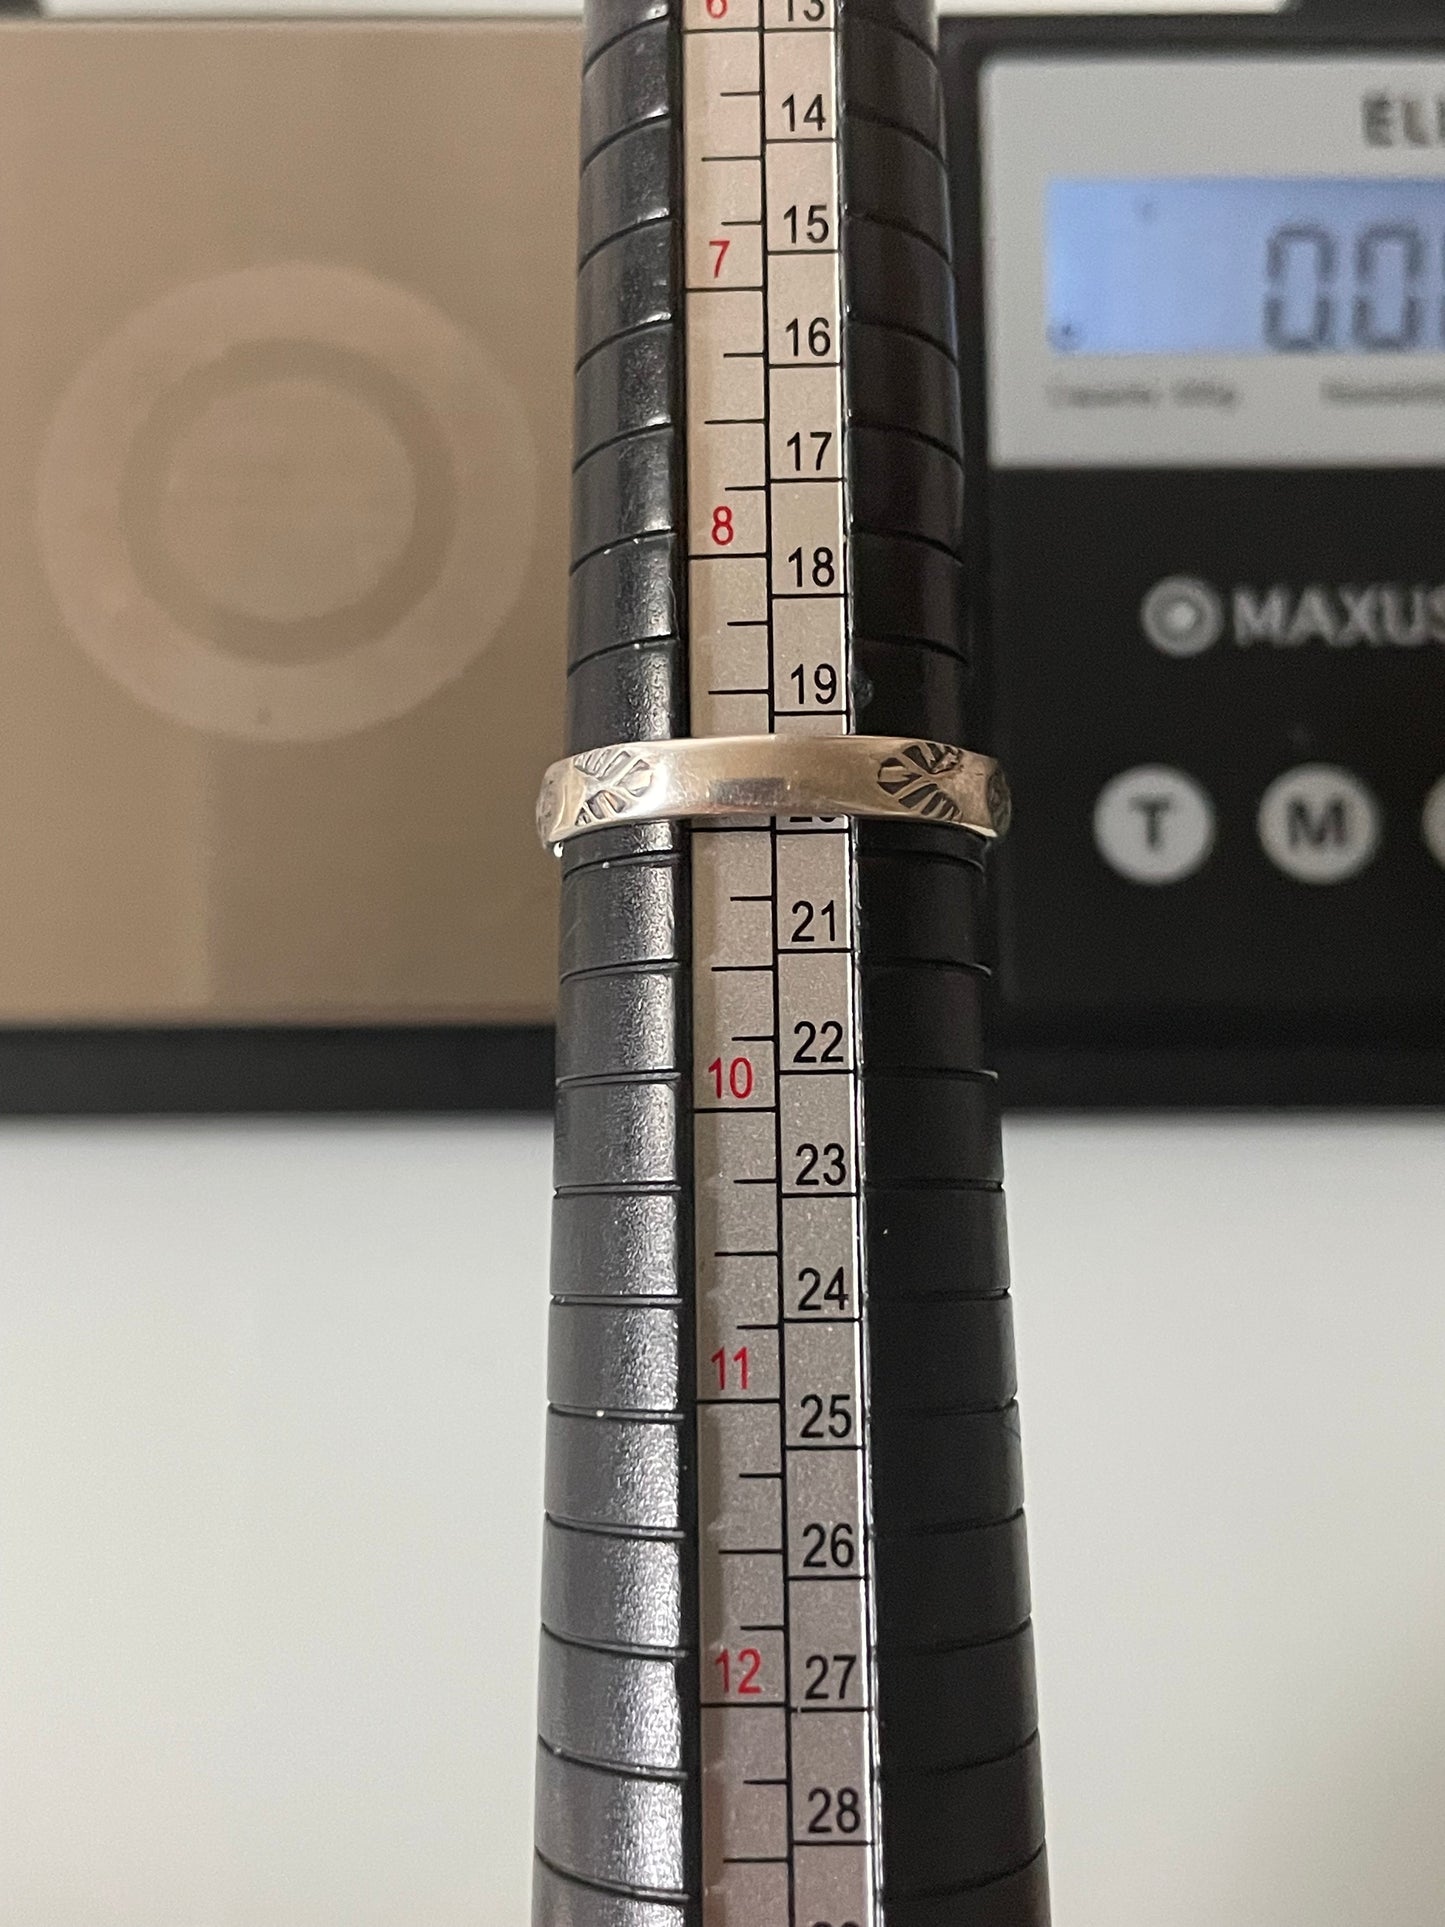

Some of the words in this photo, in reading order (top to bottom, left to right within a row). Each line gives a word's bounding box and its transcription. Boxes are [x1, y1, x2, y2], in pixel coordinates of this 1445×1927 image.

[782, 93, 826, 132] 14
[1361, 91, 1445, 148] EL
[783, 204, 829, 244] 15
[709, 238, 731, 277] 7
[1263, 222, 1445, 351] 00
[785, 317, 831, 357] 16
[786, 431, 833, 472] 17
[710, 504, 735, 547] 8
[788, 546, 835, 588] 18
[790, 663, 837, 705] 19
[1129, 792, 1172, 849] T
[1286, 797, 1345, 849] M
[791, 899, 836, 943] 21
[792, 1020, 844, 1064] 22
[708, 1056, 754, 1100] 10
[794, 1142, 847, 1187] 23
[797, 1266, 850, 1312] 24
[713, 1346, 749, 1389] 11
[799, 1393, 852, 1439] 25
[801, 1522, 856, 1569] 26
[717, 1647, 762, 1695] 12
[804, 1653, 858, 1701] 27
[807, 1786, 862, 1835] 28
